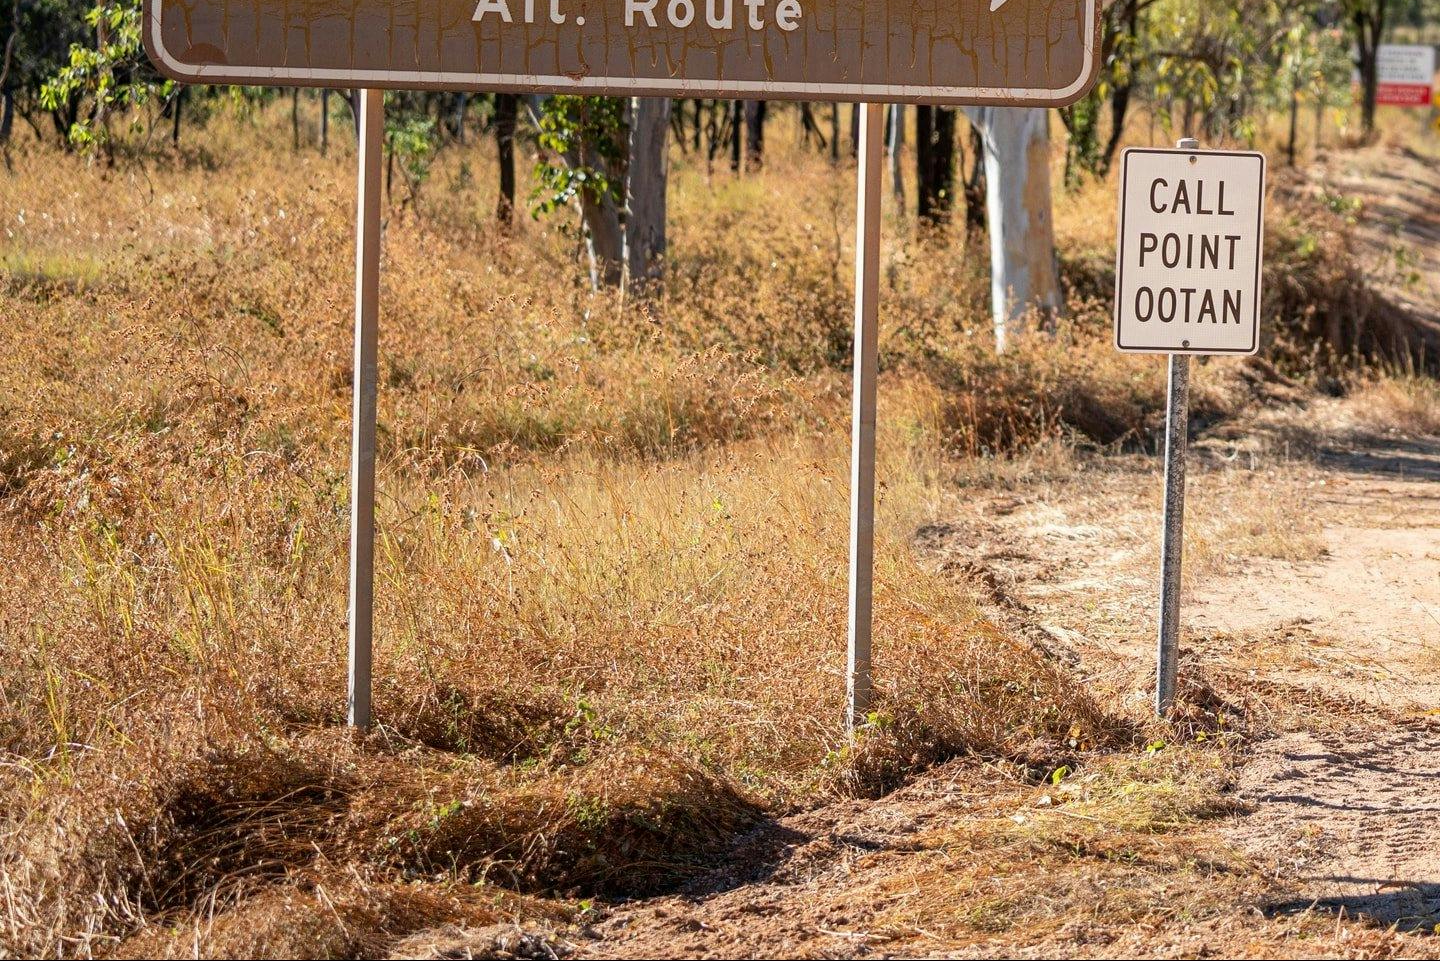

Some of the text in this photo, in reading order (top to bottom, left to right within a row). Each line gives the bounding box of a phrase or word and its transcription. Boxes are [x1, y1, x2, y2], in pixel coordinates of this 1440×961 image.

[1149, 177, 1235, 216] CALL
[1138, 232, 1242, 270] POINT
[1134, 286, 1242, 325] OOTAN
